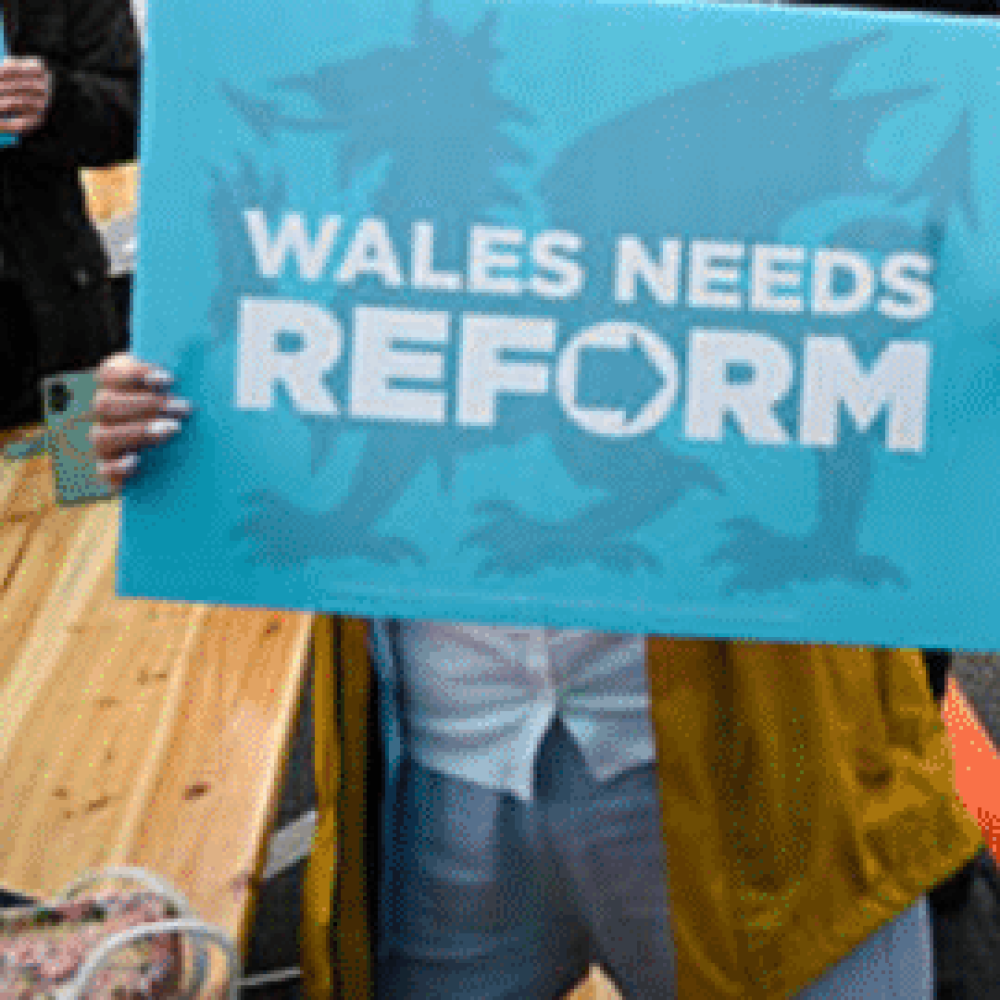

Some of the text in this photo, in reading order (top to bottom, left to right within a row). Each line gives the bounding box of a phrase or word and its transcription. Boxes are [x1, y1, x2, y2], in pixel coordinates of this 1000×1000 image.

[242, 208, 935, 319] WALES NEEDS
[234, 297, 932, 453] REFORM
